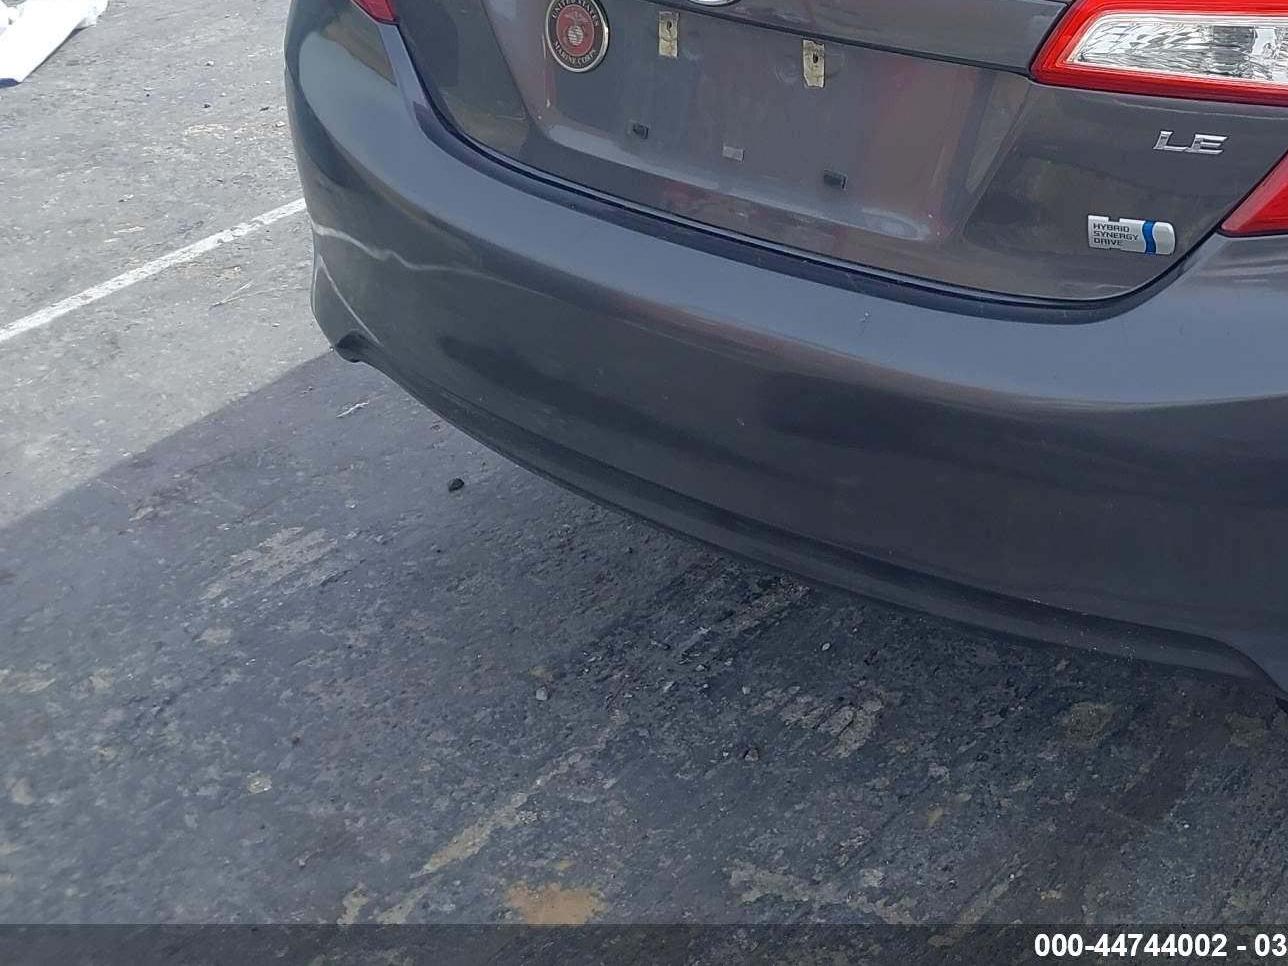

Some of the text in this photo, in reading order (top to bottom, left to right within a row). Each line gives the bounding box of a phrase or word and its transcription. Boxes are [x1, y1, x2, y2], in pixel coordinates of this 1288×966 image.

[553, 41, 597, 65] MARINE CORPS
[1152, 129, 1228, 155] LE
[1093, 222, 1130, 233] HYBRID
[1093, 230, 1139, 241] SYNERGY
[1093, 237, 1123, 246] DRIVE
